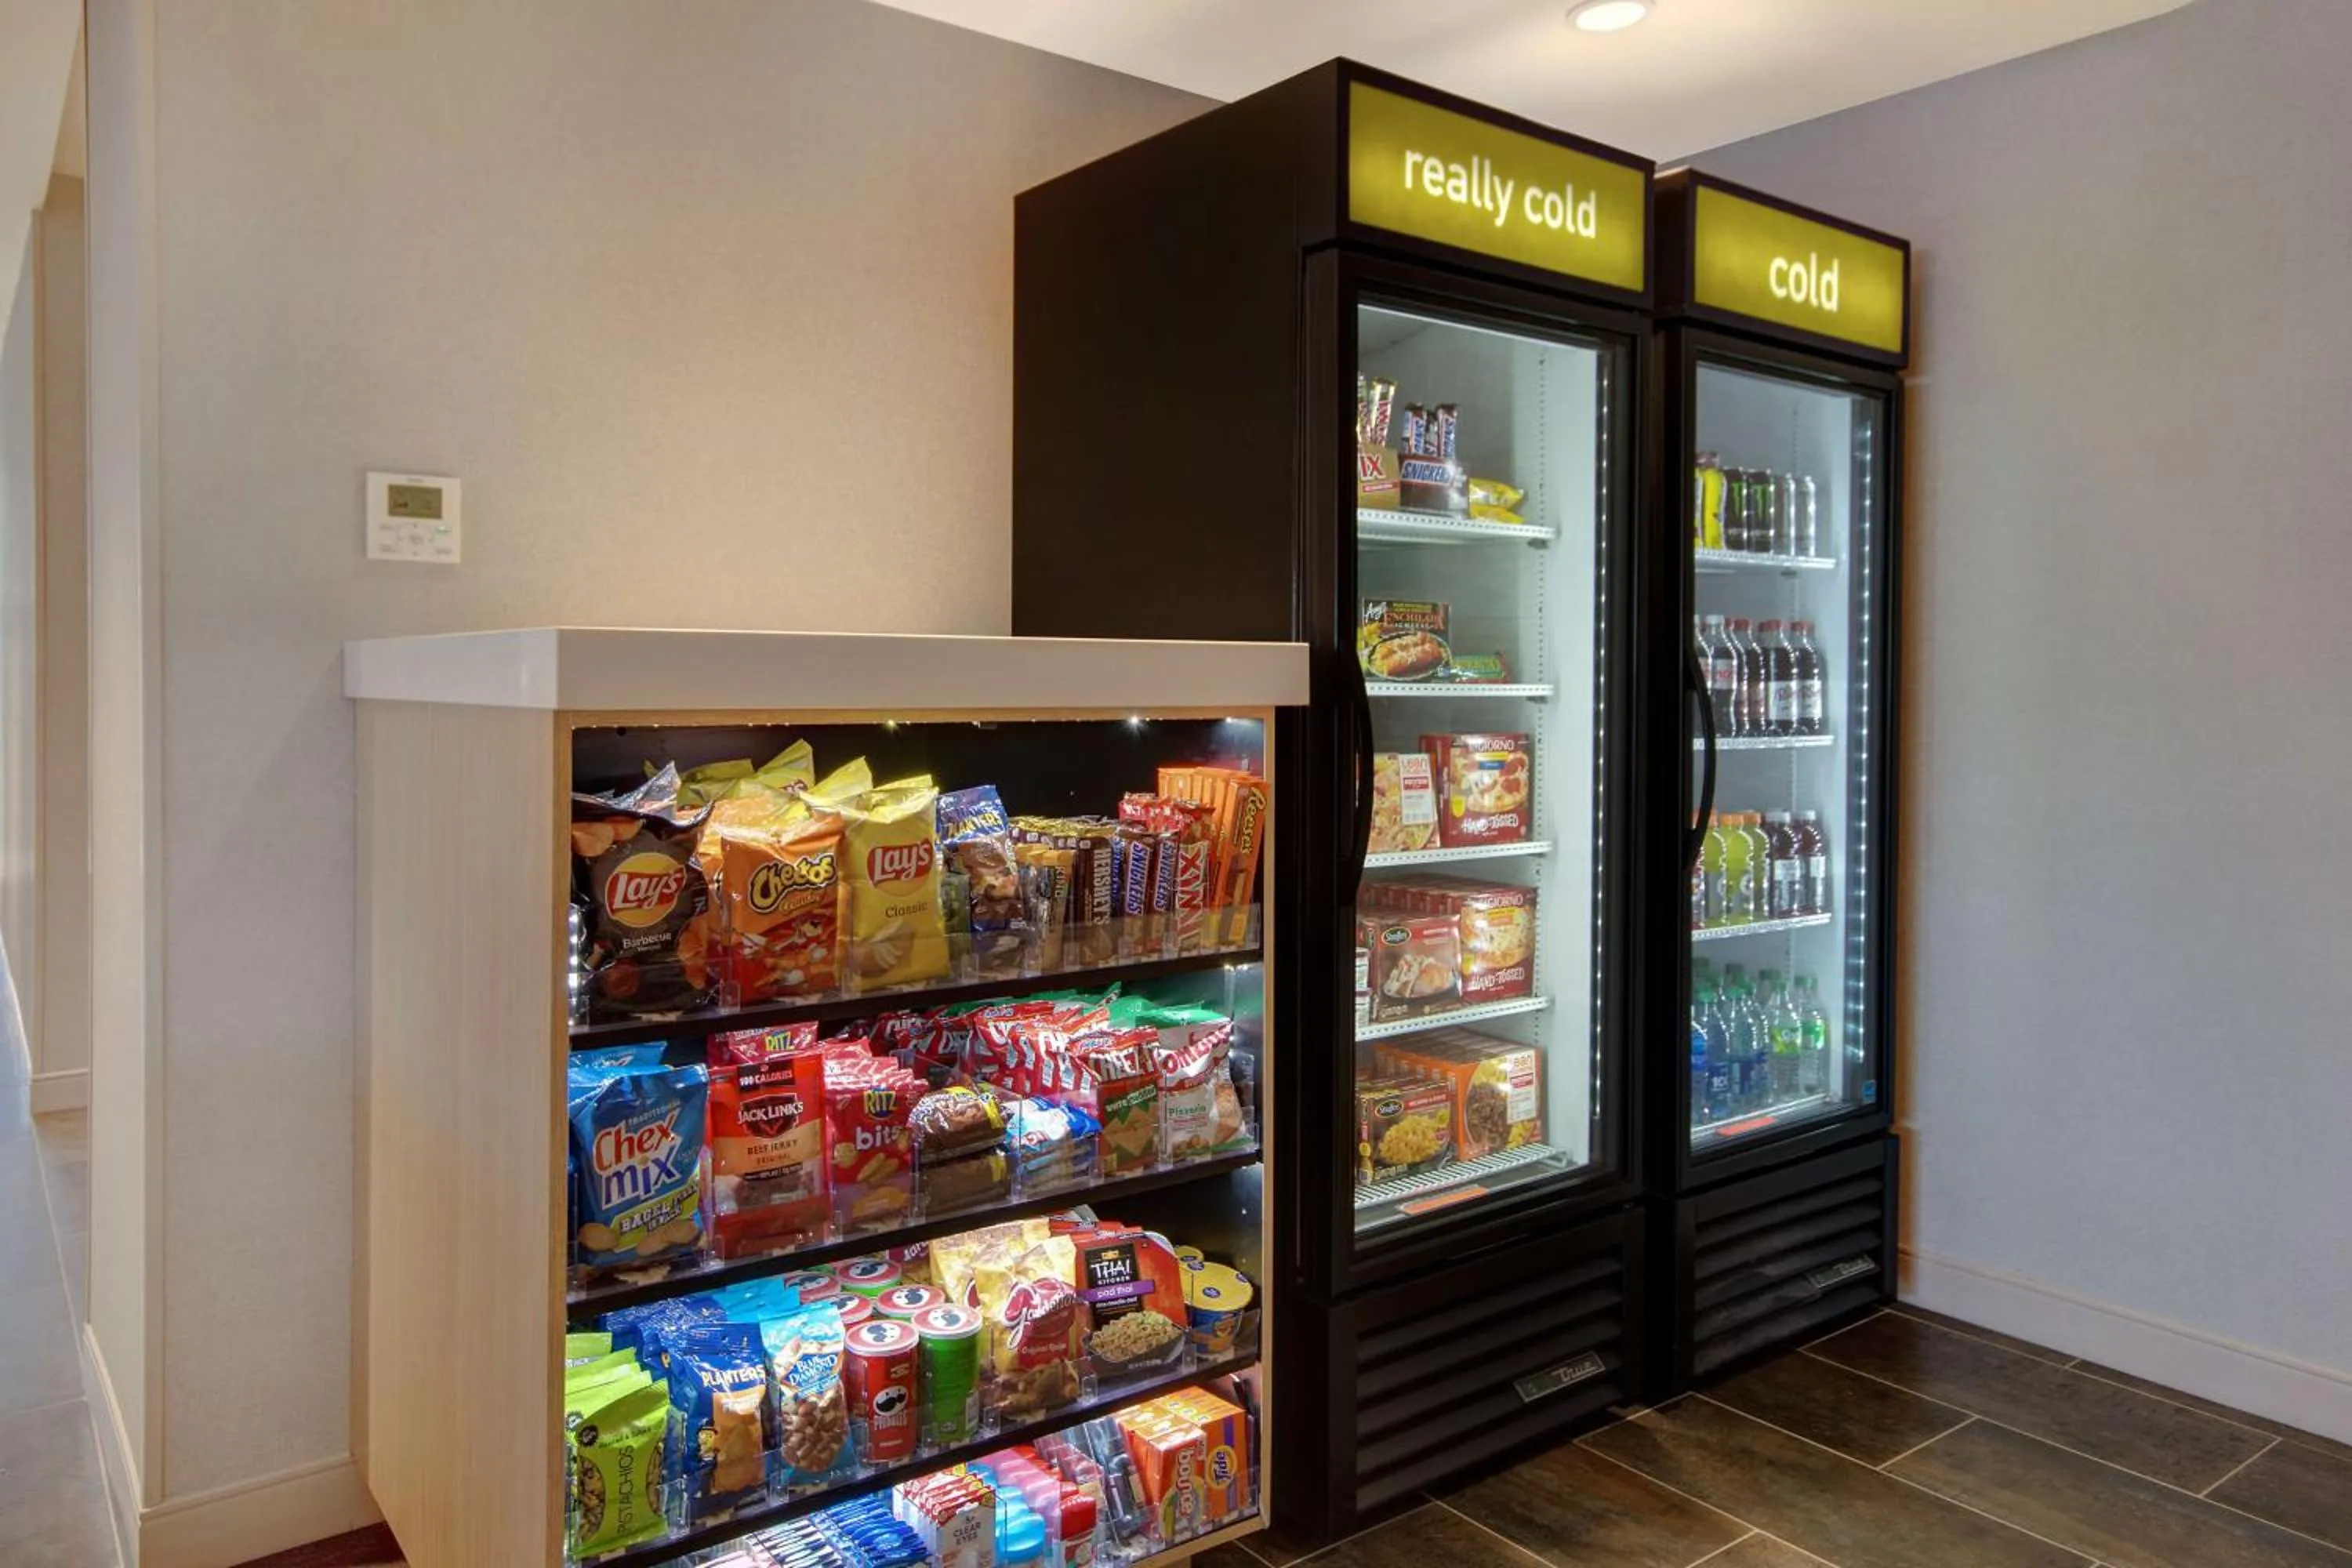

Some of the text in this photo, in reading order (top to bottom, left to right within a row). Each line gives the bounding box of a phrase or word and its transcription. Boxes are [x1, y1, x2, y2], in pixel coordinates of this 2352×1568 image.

[1403, 149, 1597, 238] really cold
[1769, 252, 1839, 312] cold
[750, 853, 837, 913] Cheetos
[871, 841, 933, 884] Lay's
[1093, 848, 1112, 925] HERSHEY'S
[1128, 844, 1149, 915] SNICKERS
[1155, 842, 1175, 910] SNICKERS
[612, 870, 683, 909] Lay's
[885, 900, 929, 920] Classic
[1178, 852, 1203, 940] TWIX
[622, 931, 672, 950] Barbecue
[864, 1091, 896, 1114] RITZ
[596, 1114, 677, 1171] Chex
[604, 1145, 676, 1205] mix
[1091, 1259, 1131, 1280] THAI
[702, 1366, 766, 1387] PLANTERS
[1177, 1447, 1195, 1517] bounce
[1214, 1451, 1232, 1483] Tide
[953, 1522, 982, 1537] CLEAR
[956, 1533, 978, 1544] EYES
